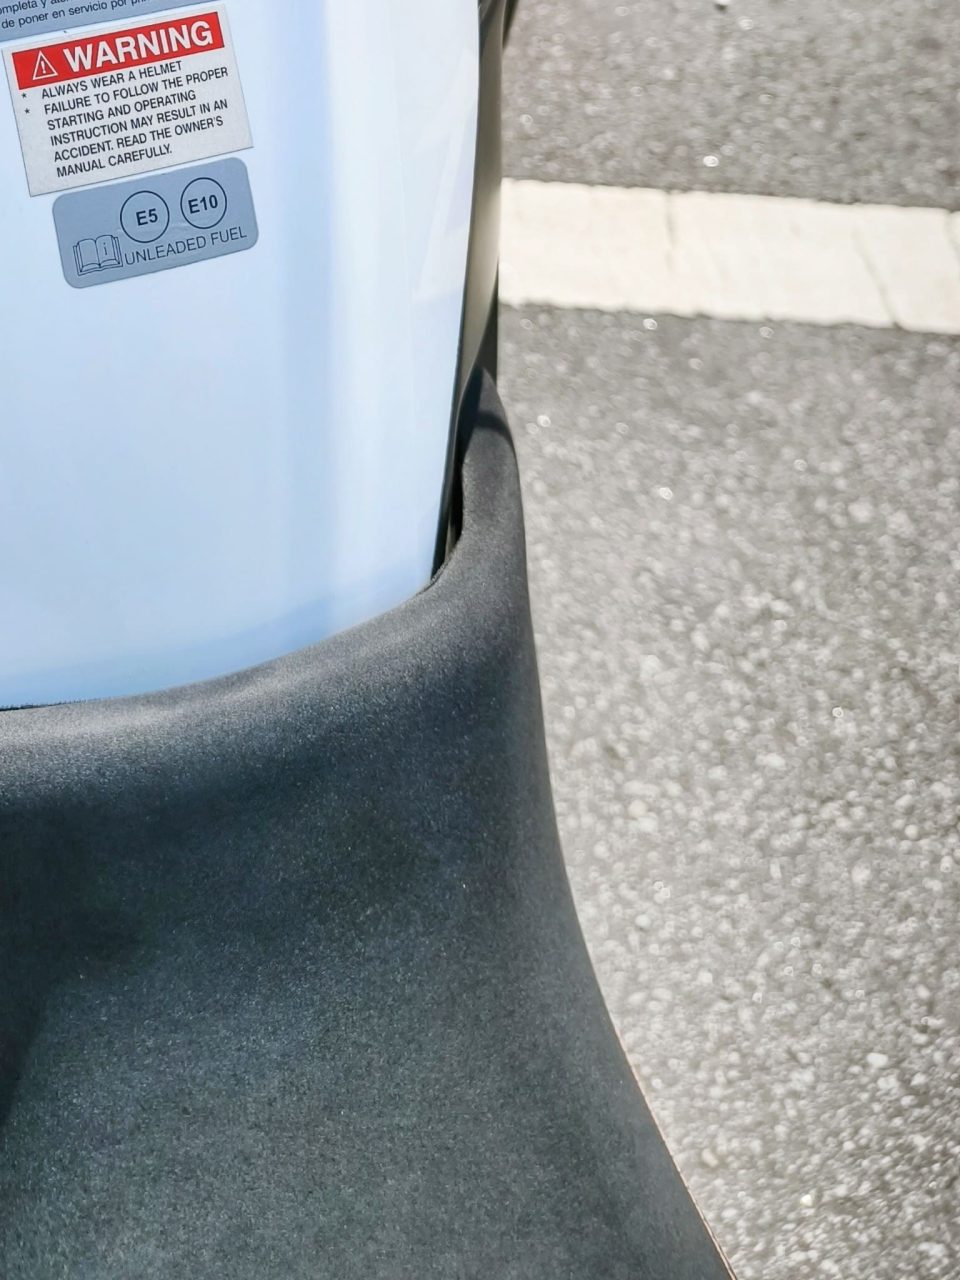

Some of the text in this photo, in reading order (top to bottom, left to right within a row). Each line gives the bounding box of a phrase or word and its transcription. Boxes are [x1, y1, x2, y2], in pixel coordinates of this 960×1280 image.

[1, 19, 15, 29] de
[18, 12, 49, 28] poner
[51, 9, 65, 19] en
[68, 0, 107, 16] servicio
[41, 0, 47, 8] y
[63, 20, 213, 72] WARNING
[41, 60, 182, 99] ALWAYS WEAR A HELMET
[44, 66, 228, 115] FAILURE TO FOLLOW THE PROPER
[47, 89, 197, 131] STARTING AND OPERATING
[50, 99, 228, 146] INSTRUCTION MAY RESULT IN AN
[54, 115, 224, 163] ACCIDENT. READ THE OWNER'S
[57, 143, 173, 178] MANUAL CAREFULLY.
[136, 194, 218, 226] E5 E10
[124, 225, 247, 266] UNLEADED FUEL
